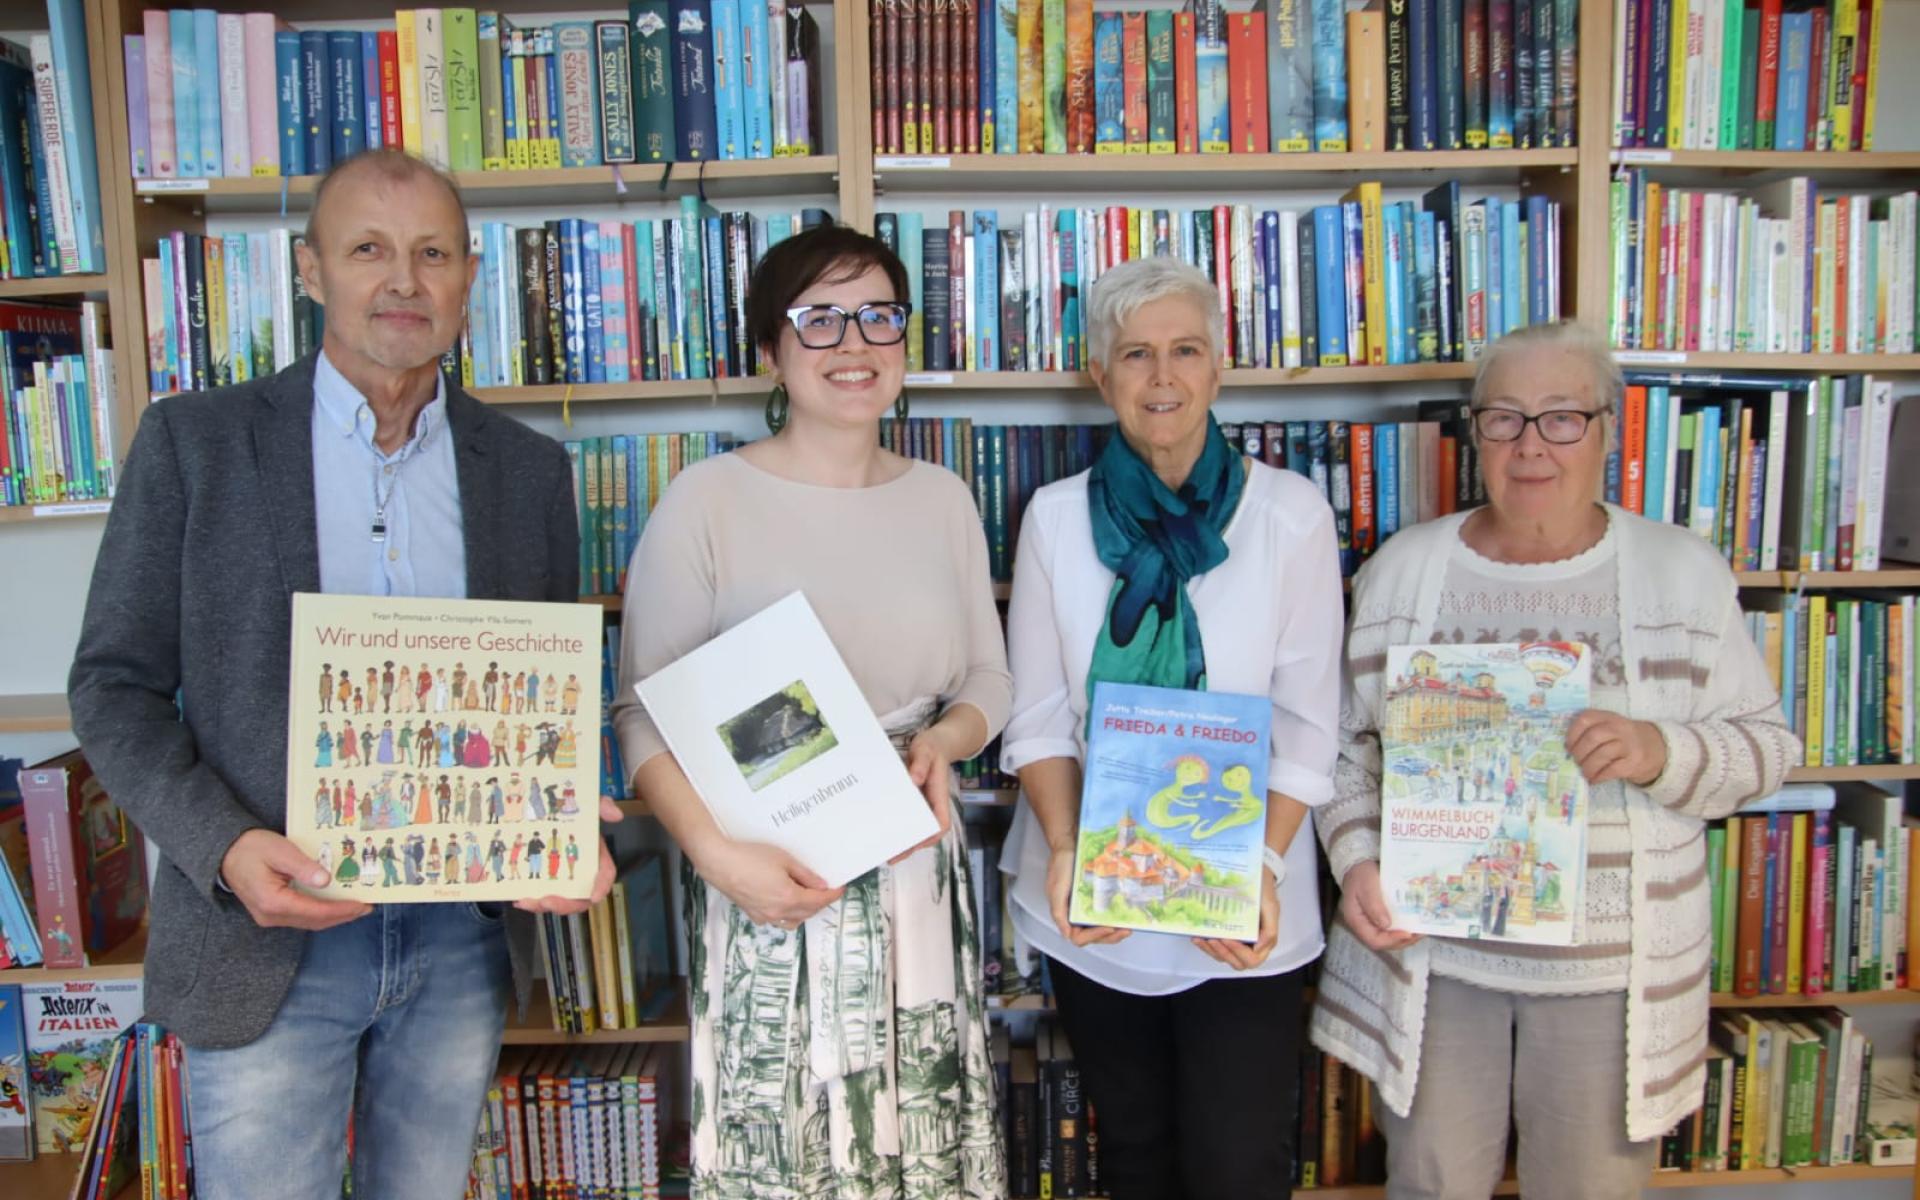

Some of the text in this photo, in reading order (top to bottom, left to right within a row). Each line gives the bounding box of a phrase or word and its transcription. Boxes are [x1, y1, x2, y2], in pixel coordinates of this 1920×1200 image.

[1389, 19, 1402, 106] HARRY POTTER
[38, 77, 61, 147] SUPERERDE
[563, 52, 581, 145] SALLY JONES
[604, 52, 620, 141] SALLY JONES
[189, 280, 206, 327] Coraline
[315, 625, 584, 654] Wir und unsere Geschichte
[1103, 717, 1258, 745] FRIEDA & FRIEDO
[770, 772, 859, 828] Heiligenbrunn
[1391, 807, 1495, 823] WIMMELBUCH
[1391, 822, 1490, 841] BURGENLAND
[1747, 823, 1764, 899] Der Biogarten
[40, 995, 96, 1016] Asterix
[1064, 1069, 1079, 1114] CIRCE
